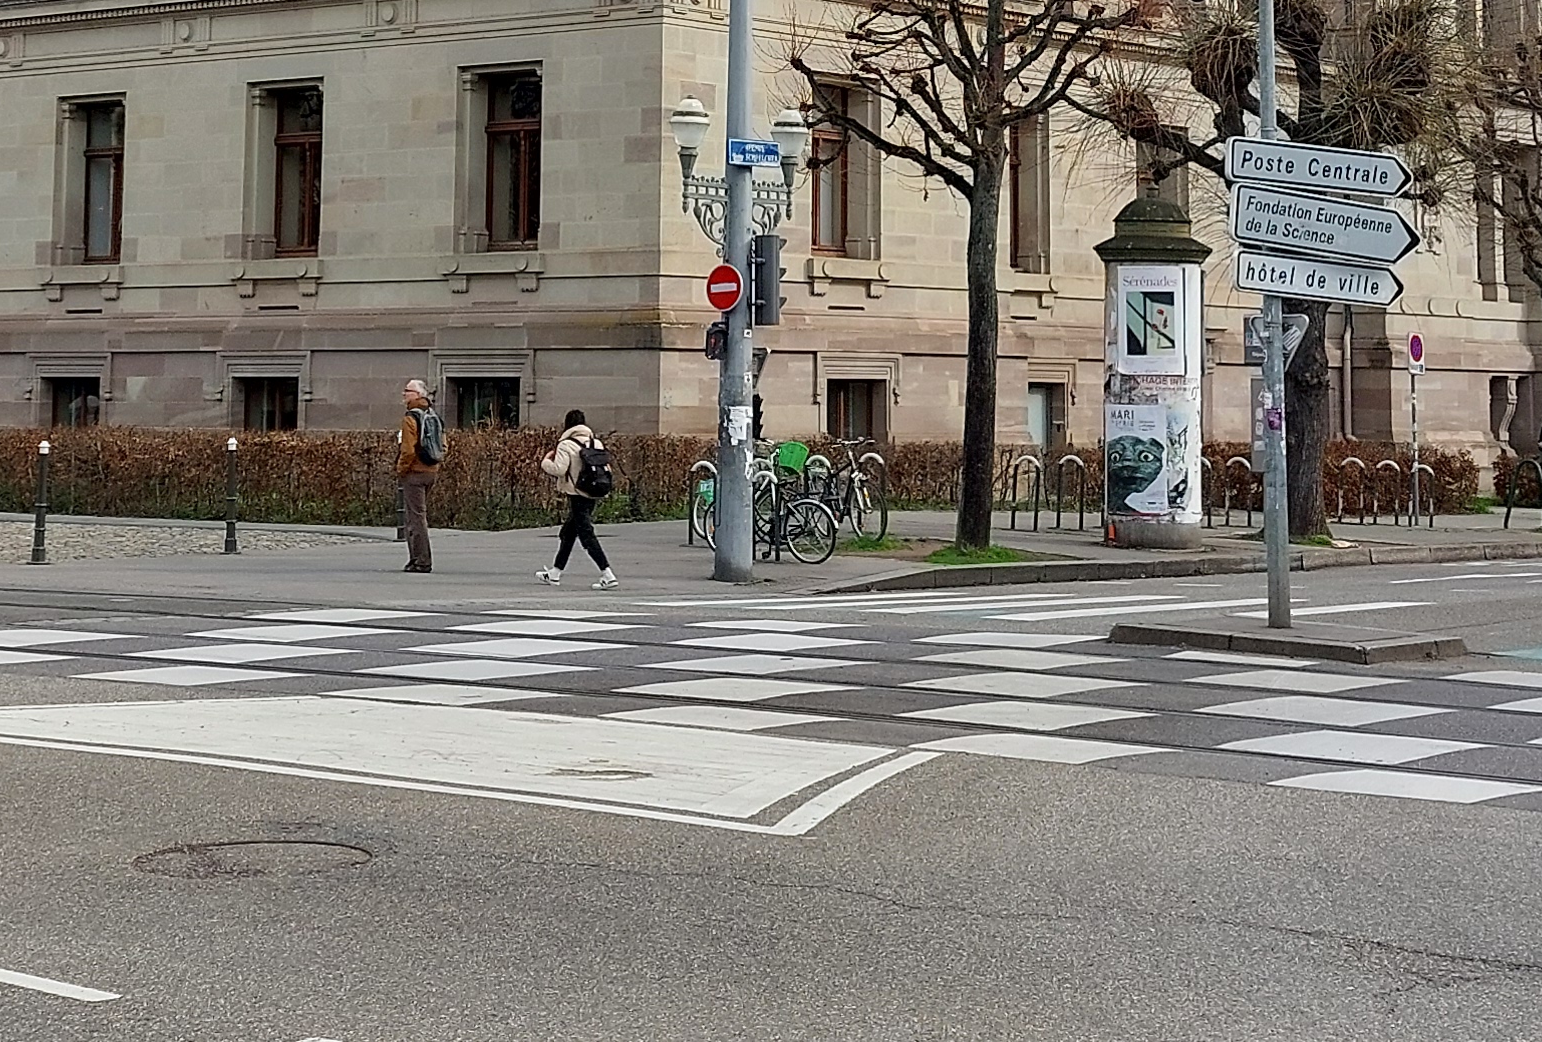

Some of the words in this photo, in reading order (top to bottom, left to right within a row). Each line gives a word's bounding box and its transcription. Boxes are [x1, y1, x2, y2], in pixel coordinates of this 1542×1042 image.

[1240, 149, 1295, 174] Poste
[1308, 158, 1389, 185] Centrale
[1245, 195, 1312, 220] Fondation
[1315, 207, 1393, 234] Européenne
[1245, 217, 1262, 233] de
[1265, 219, 1278, 236] la
[1282, 223, 1335, 245] Science
[1122, 275, 1178, 287] Sérénades
[1245, 261, 1296, 285] hôtel
[1306, 269, 1327, 289] de
[1338, 273, 1379, 295] ville
[1110, 409, 1134, 420] MARI
